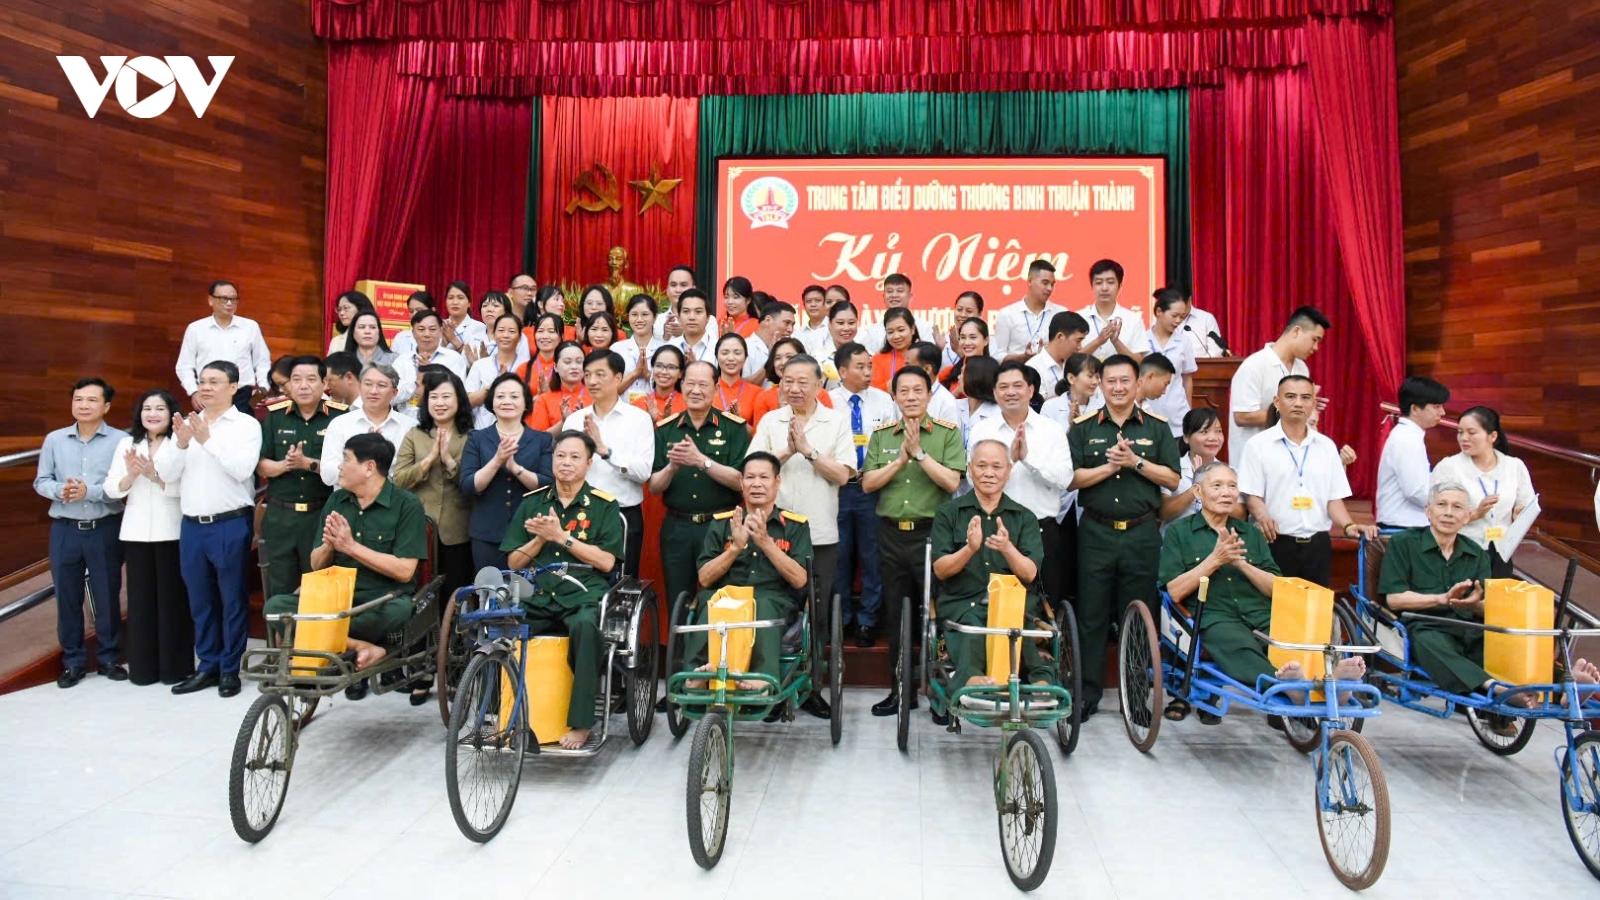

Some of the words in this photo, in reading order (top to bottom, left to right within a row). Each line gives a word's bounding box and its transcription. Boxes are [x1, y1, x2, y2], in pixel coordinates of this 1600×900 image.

[806, 185, 848, 211] TRUNG
[851, 180, 878, 211] TÂM
[913, 179, 957, 211] DƯỠNG
[960, 183, 1010, 211] THƯƠNG
[1013, 185, 1045, 211] BINH
[1047, 180, 1090, 217] THUẬN
[1092, 180, 1135, 211] THÀNH
[811, 232, 904, 291] Kỷ
